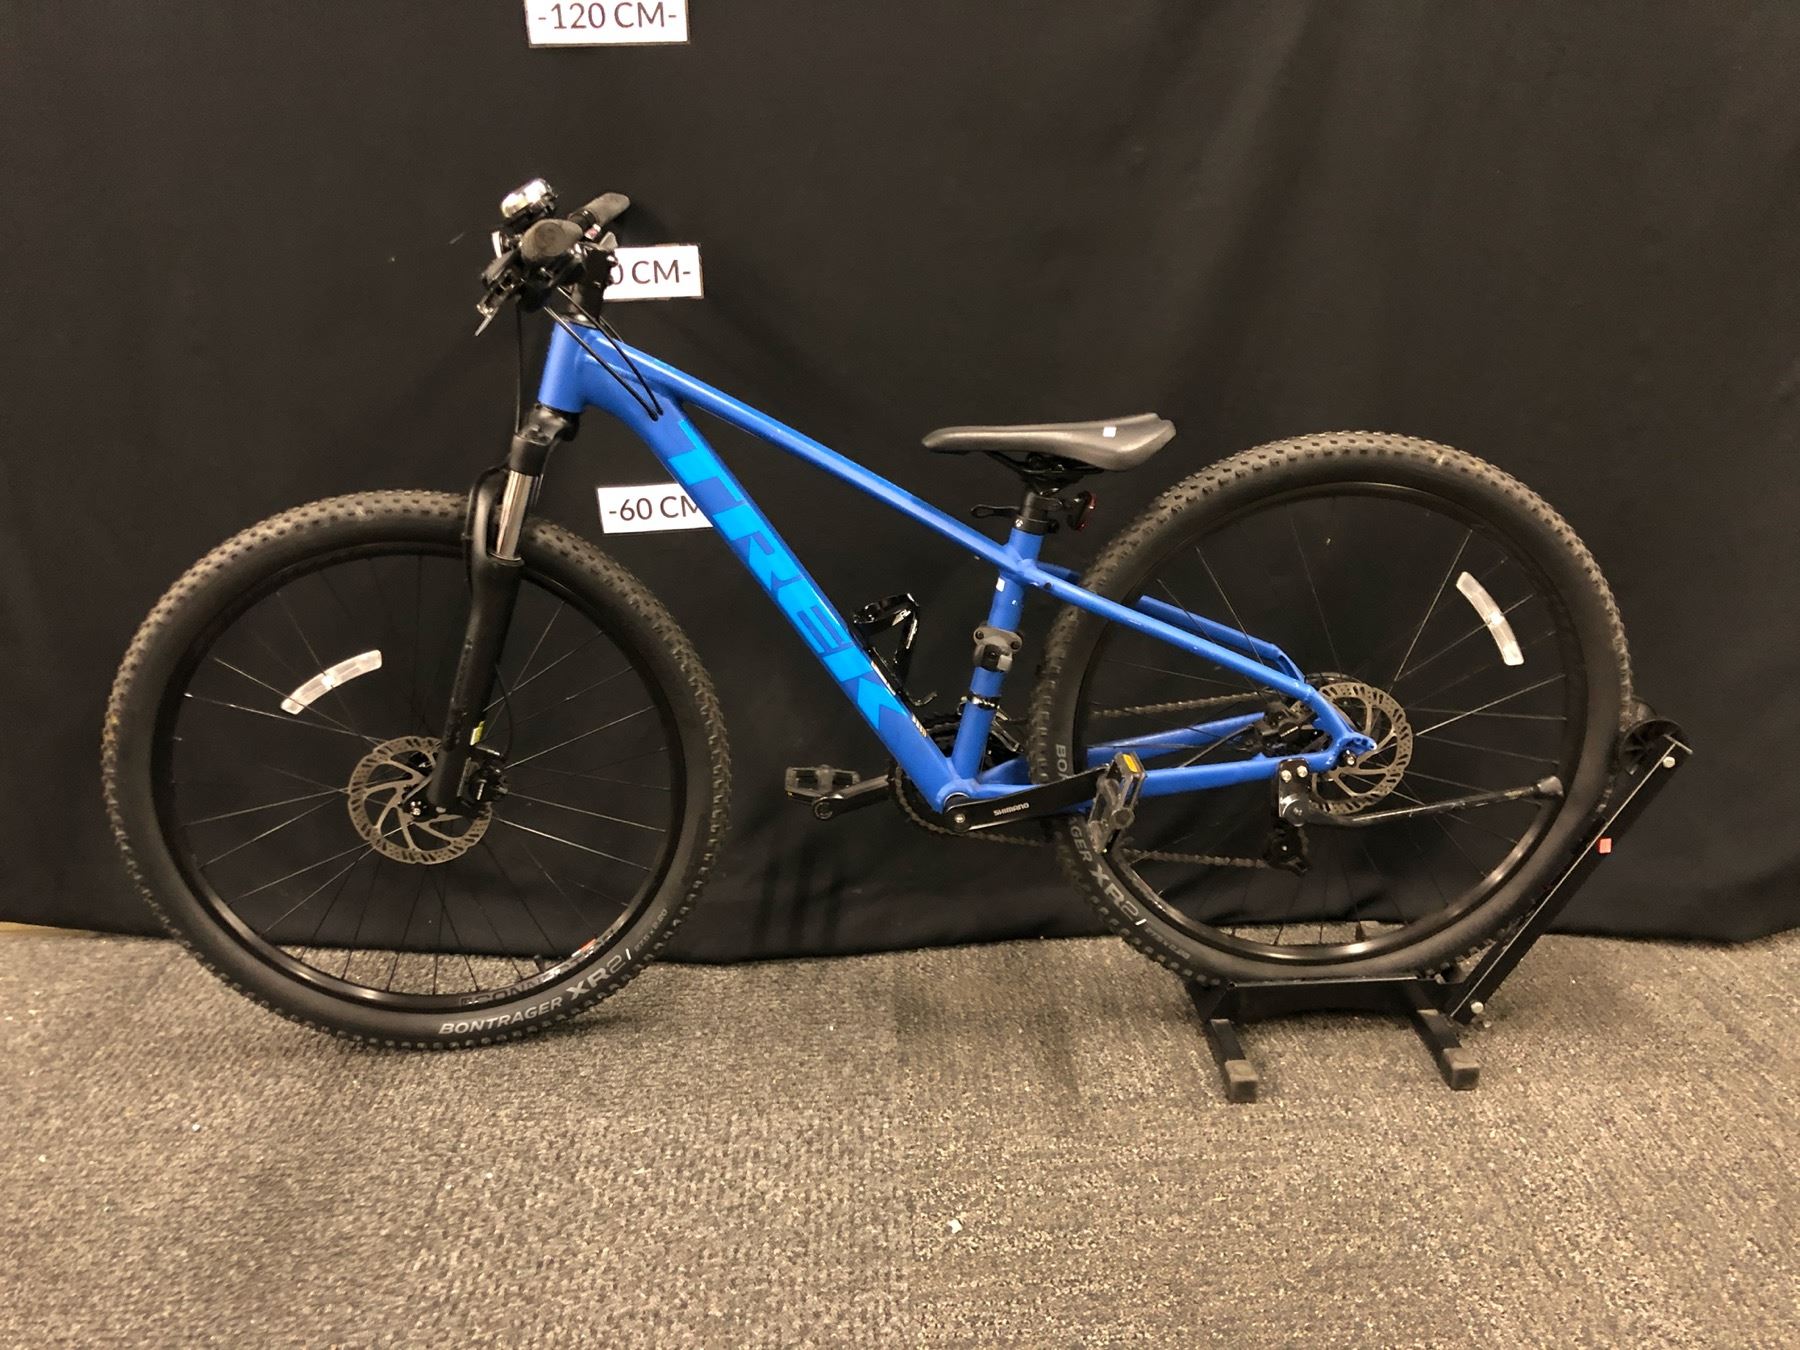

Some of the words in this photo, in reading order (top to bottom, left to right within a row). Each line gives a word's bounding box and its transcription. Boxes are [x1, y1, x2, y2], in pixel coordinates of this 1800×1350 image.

[538, 2, 606, 29] -120
[614, 2, 677, 28] CM-
[631, 259, 691, 284] CM-
[608, 497, 653, 521] -60
[993, 801, 1030, 817] SHIMANO
[438, 996, 563, 1035] BONTRAGER
